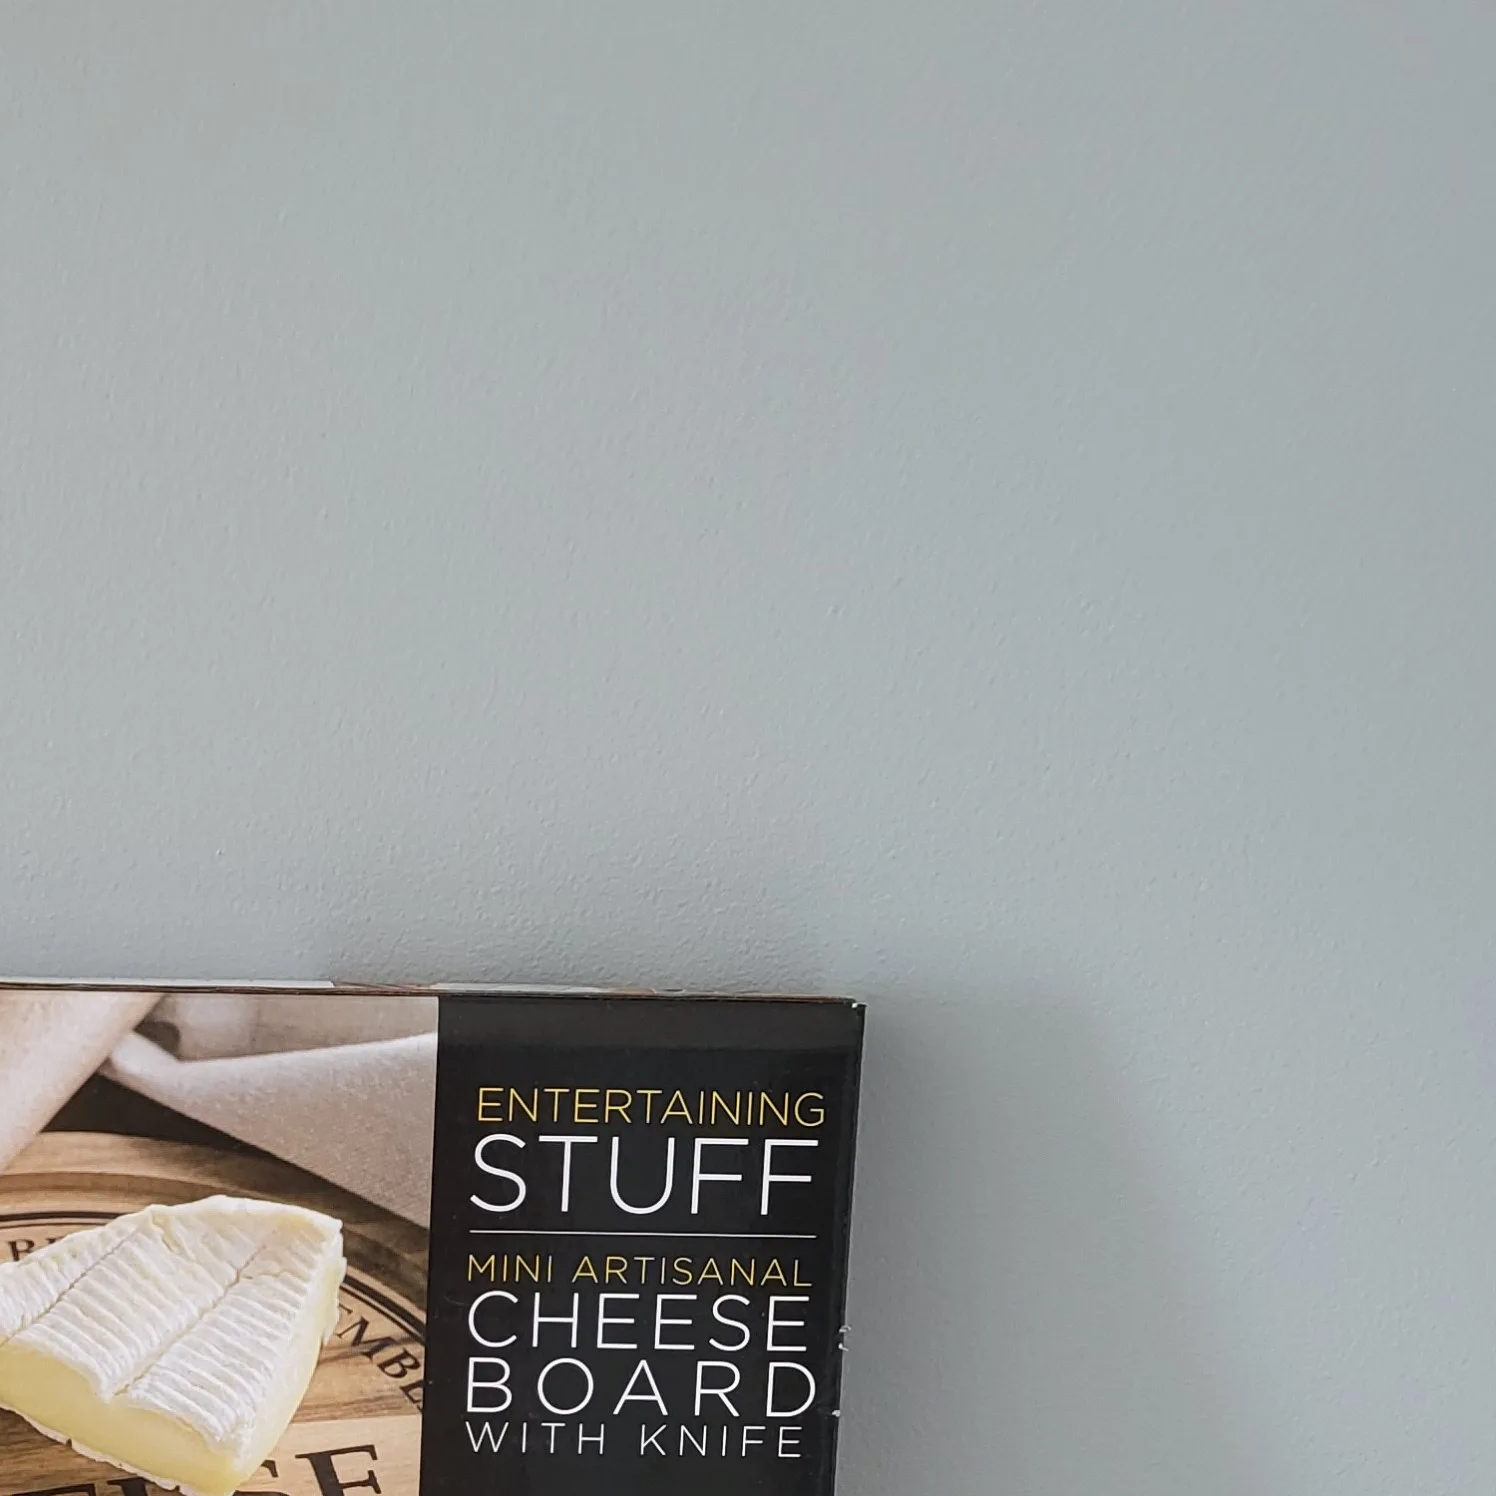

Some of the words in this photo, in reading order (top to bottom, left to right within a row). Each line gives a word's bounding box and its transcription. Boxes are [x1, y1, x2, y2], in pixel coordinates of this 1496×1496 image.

[476, 1086, 826, 1128] ENTERTAINING
[469, 1132, 820, 1216] STUFF
[466, 1253, 553, 1283] MINI
[571, 1255, 813, 1288] ARTISANAL
[467, 1290, 811, 1353] CHEESE
[465, 1356, 817, 1418] BOARD
[464, 1420, 606, 1456] WITH
[639, 1423, 804, 1458] KNIFE
